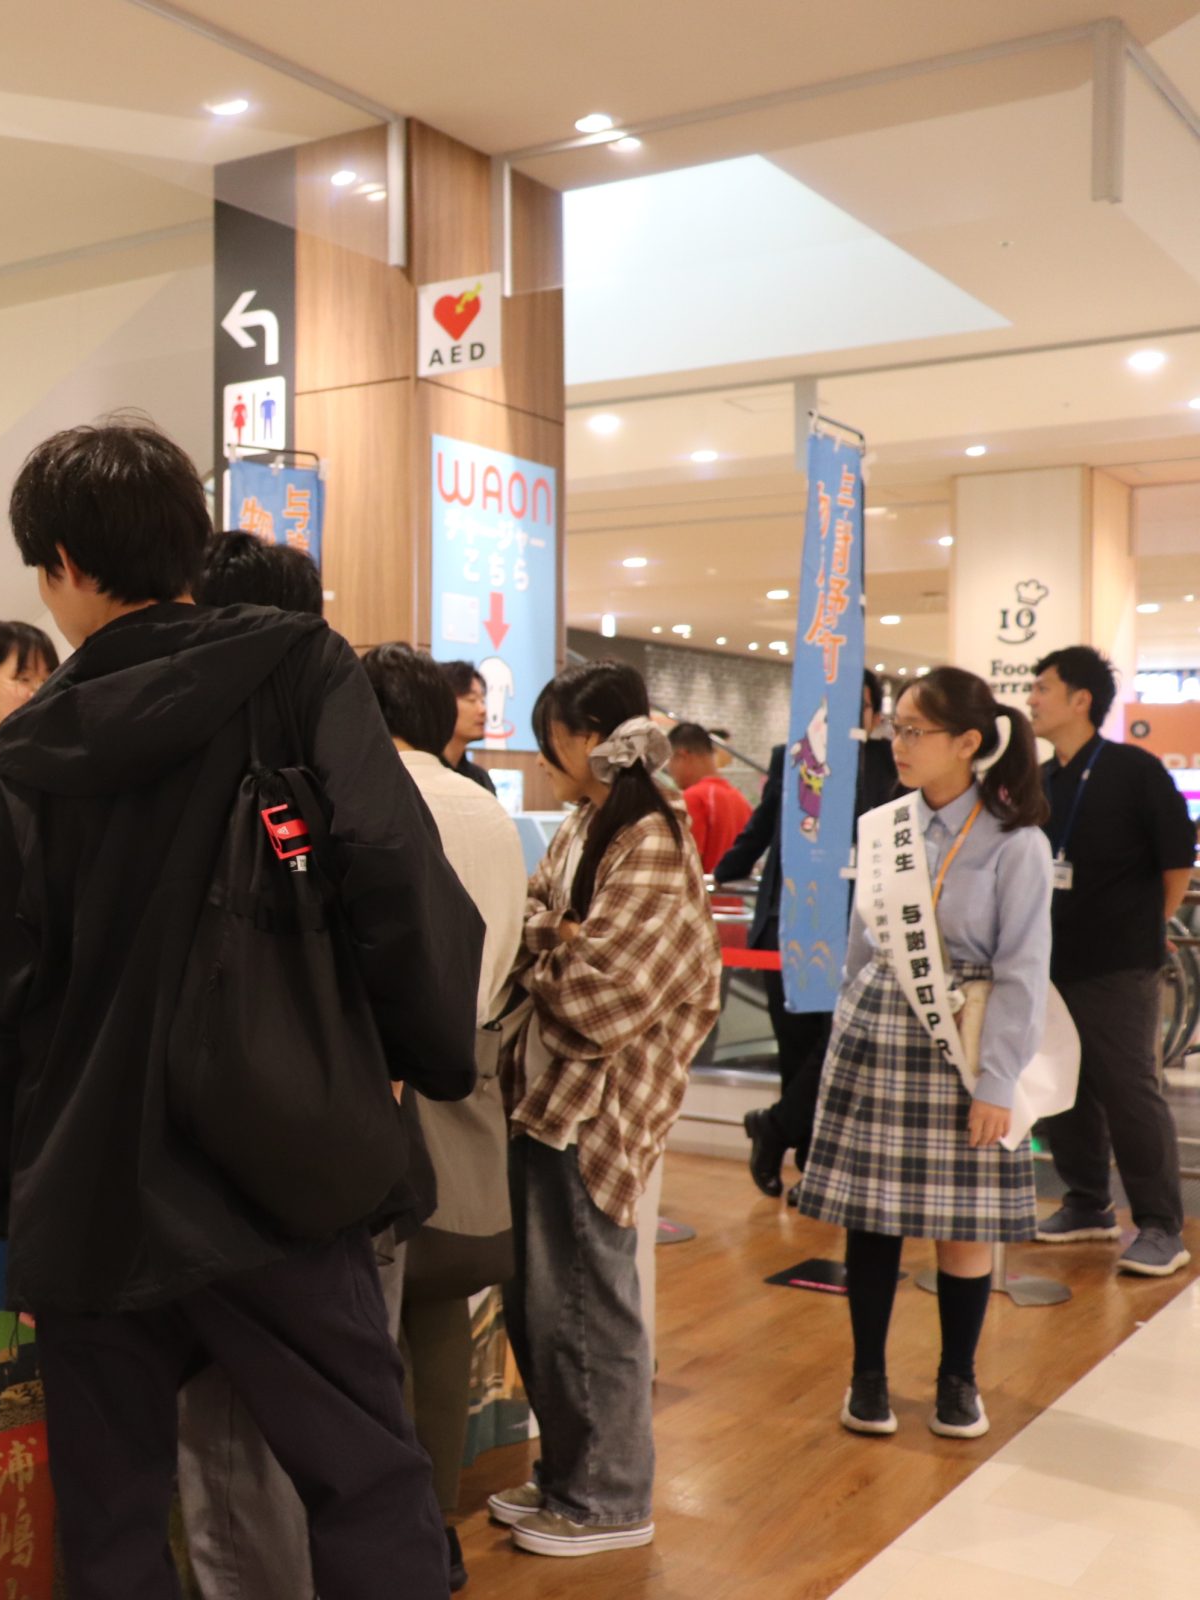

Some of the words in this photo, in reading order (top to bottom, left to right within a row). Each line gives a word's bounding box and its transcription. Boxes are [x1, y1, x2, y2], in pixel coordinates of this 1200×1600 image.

[428, 342, 485, 367] AED
[463, 548, 529, 591] こちら
[893, 804, 915, 873] 高校生
